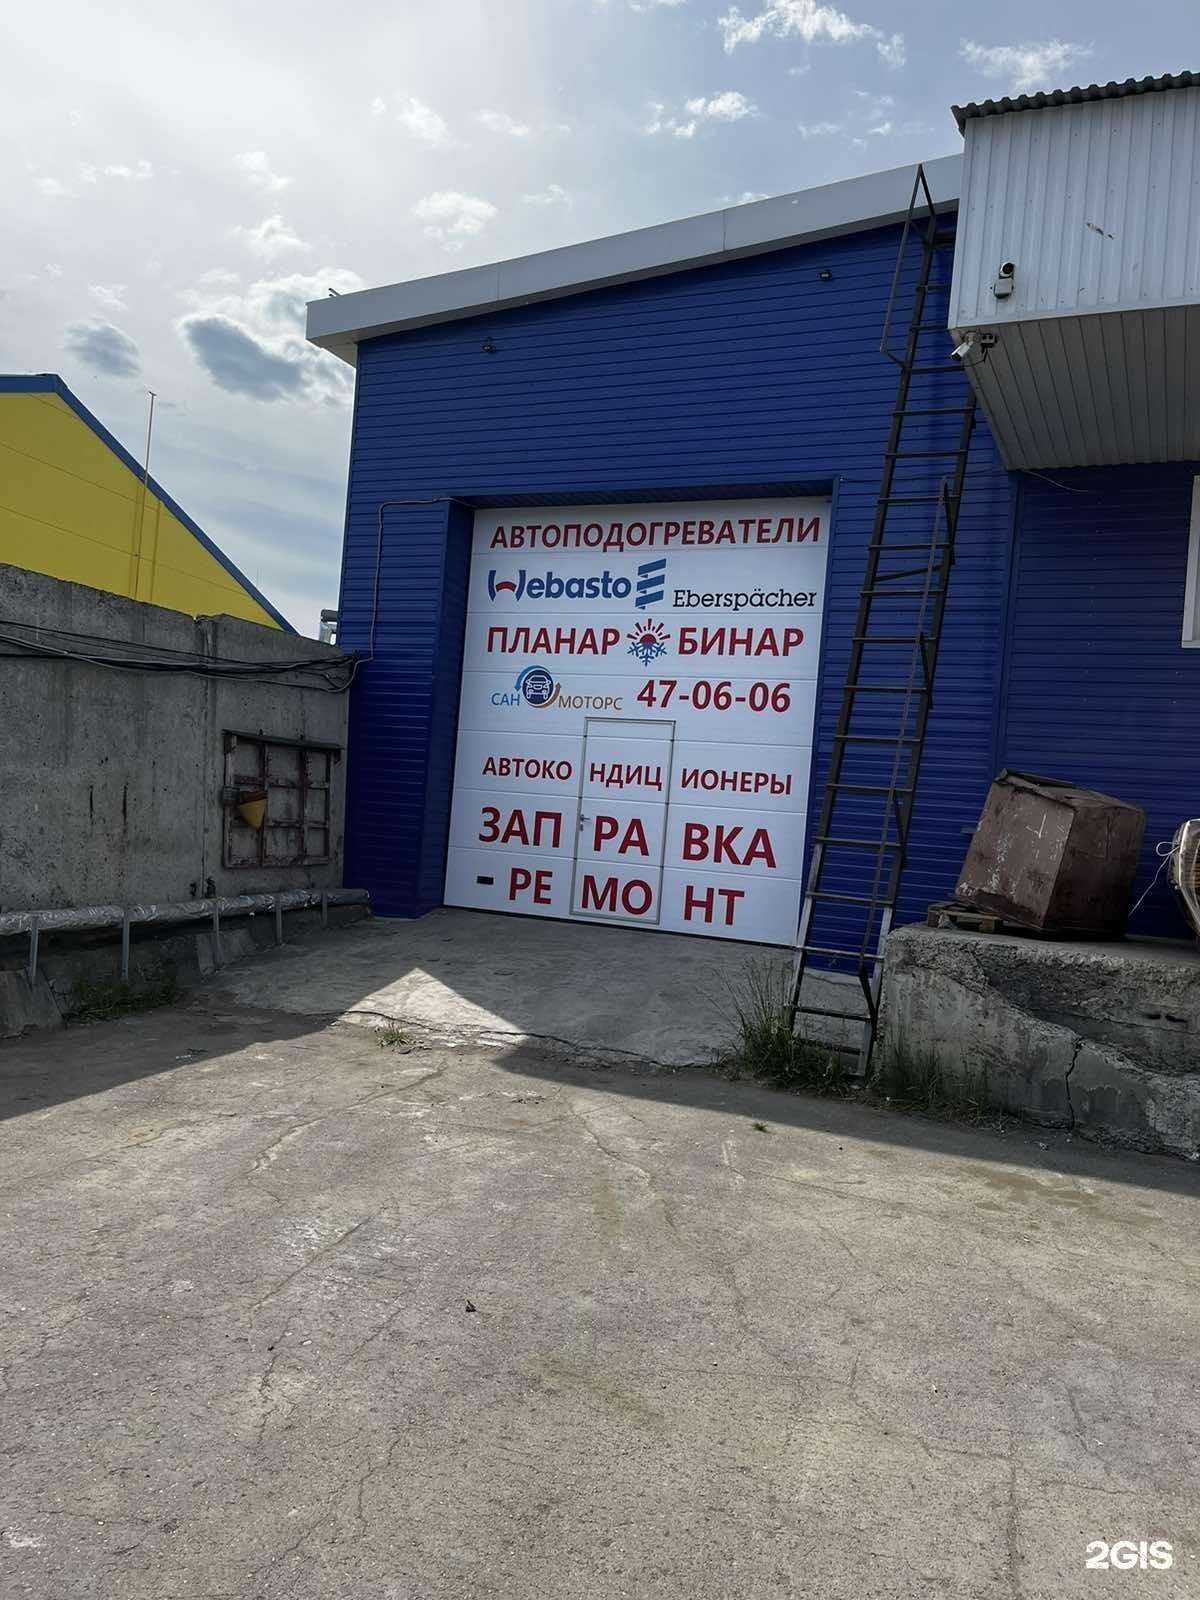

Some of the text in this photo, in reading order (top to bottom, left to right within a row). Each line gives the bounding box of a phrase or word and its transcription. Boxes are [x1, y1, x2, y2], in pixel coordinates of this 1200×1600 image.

[490, 517, 821, 552] АВТОПОДОГРЕВАТЕЛИ
[488, 569, 632, 601] Webasto
[672, 588, 817, 611] Eberspächer
[487, 627, 804, 657] ПЛАНАР БИНАР
[491, 692, 623, 711] САН МОТОРС
[637, 679, 791, 713] 47-06-06
[482, 756, 793, 796] АВТОКО НДИЦ ИОНЕРЫ
[478, 806, 777, 868] ЗАП РА ВКА
[508, 867, 745, 926] РЕ МО НТ
